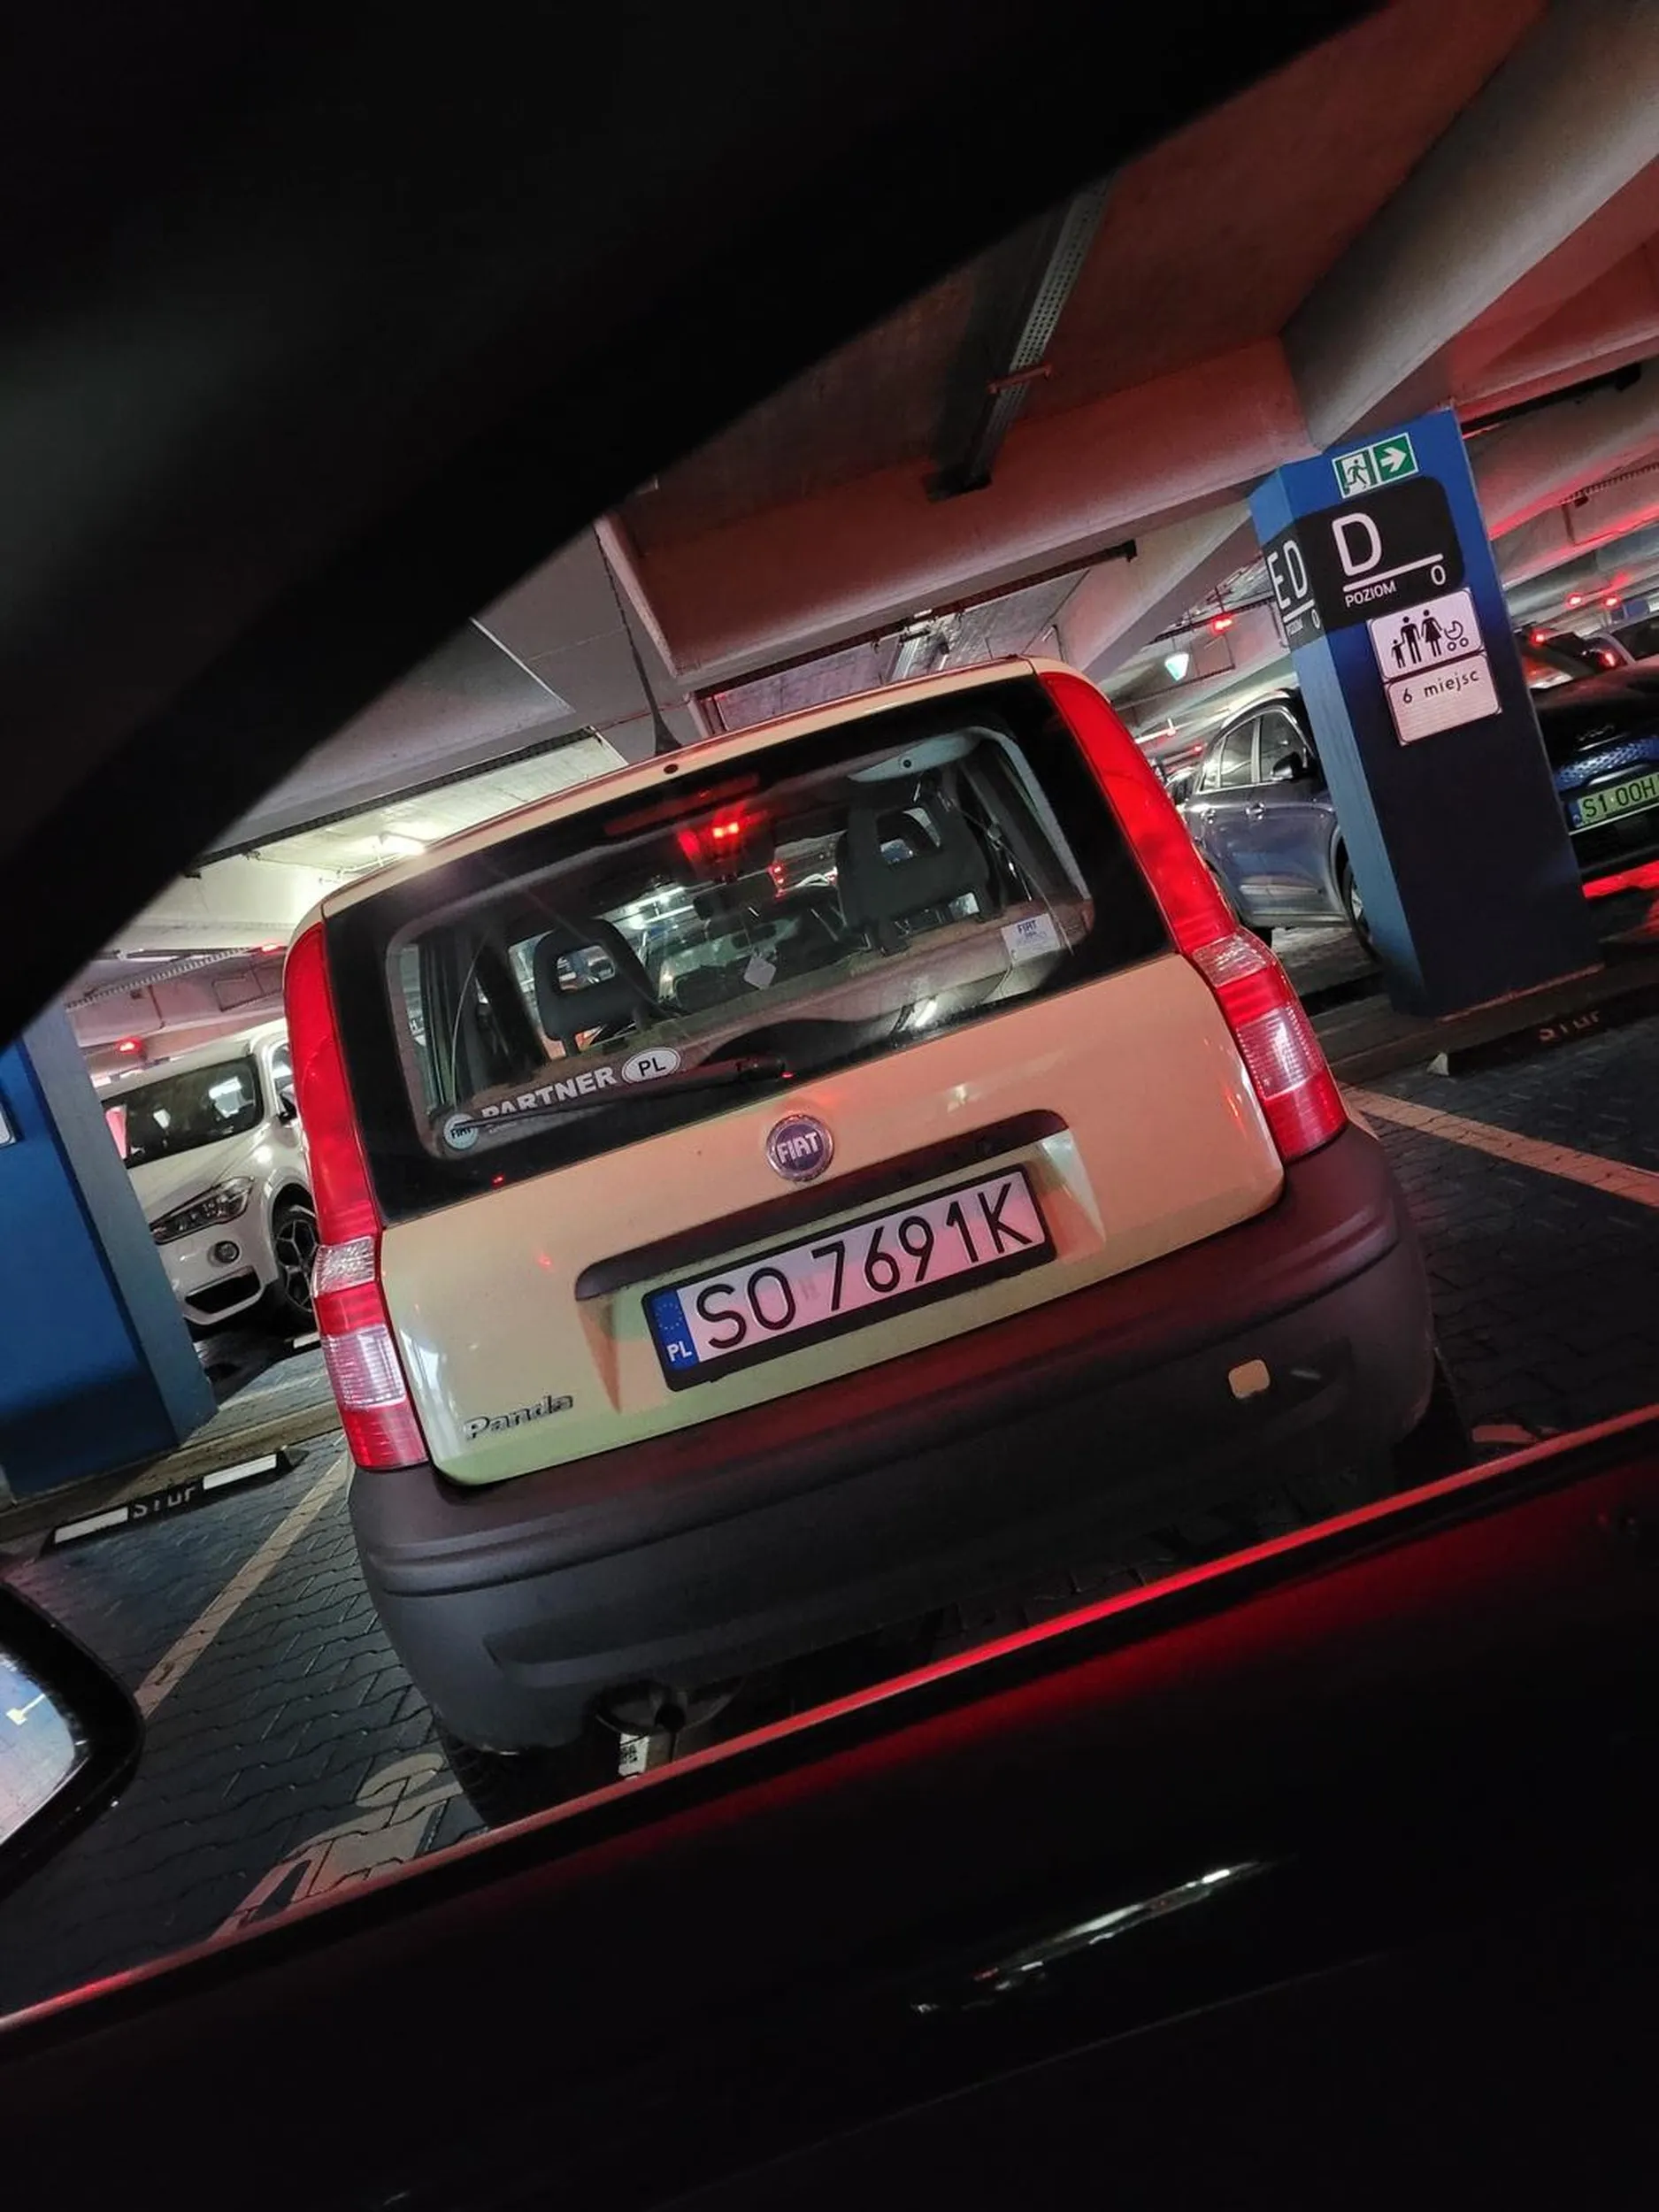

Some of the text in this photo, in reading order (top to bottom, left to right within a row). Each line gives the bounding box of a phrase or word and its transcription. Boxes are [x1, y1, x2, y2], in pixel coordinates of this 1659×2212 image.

[1332, 513, 1382, 576] D
[1267, 540, 1308, 610] ED
[1345, 580, 1397, 608] POZIOM
[1402, 670, 1480, 704] 6 miejsc
[480, 1057, 665, 1118] PARTNER PL
[776, 1132, 819, 1164] FIAT
[695, 1183, 1033, 1349] SO 7691K
[666, 1341, 692, 1363] PL
[464, 1394, 574, 1440] Panda
